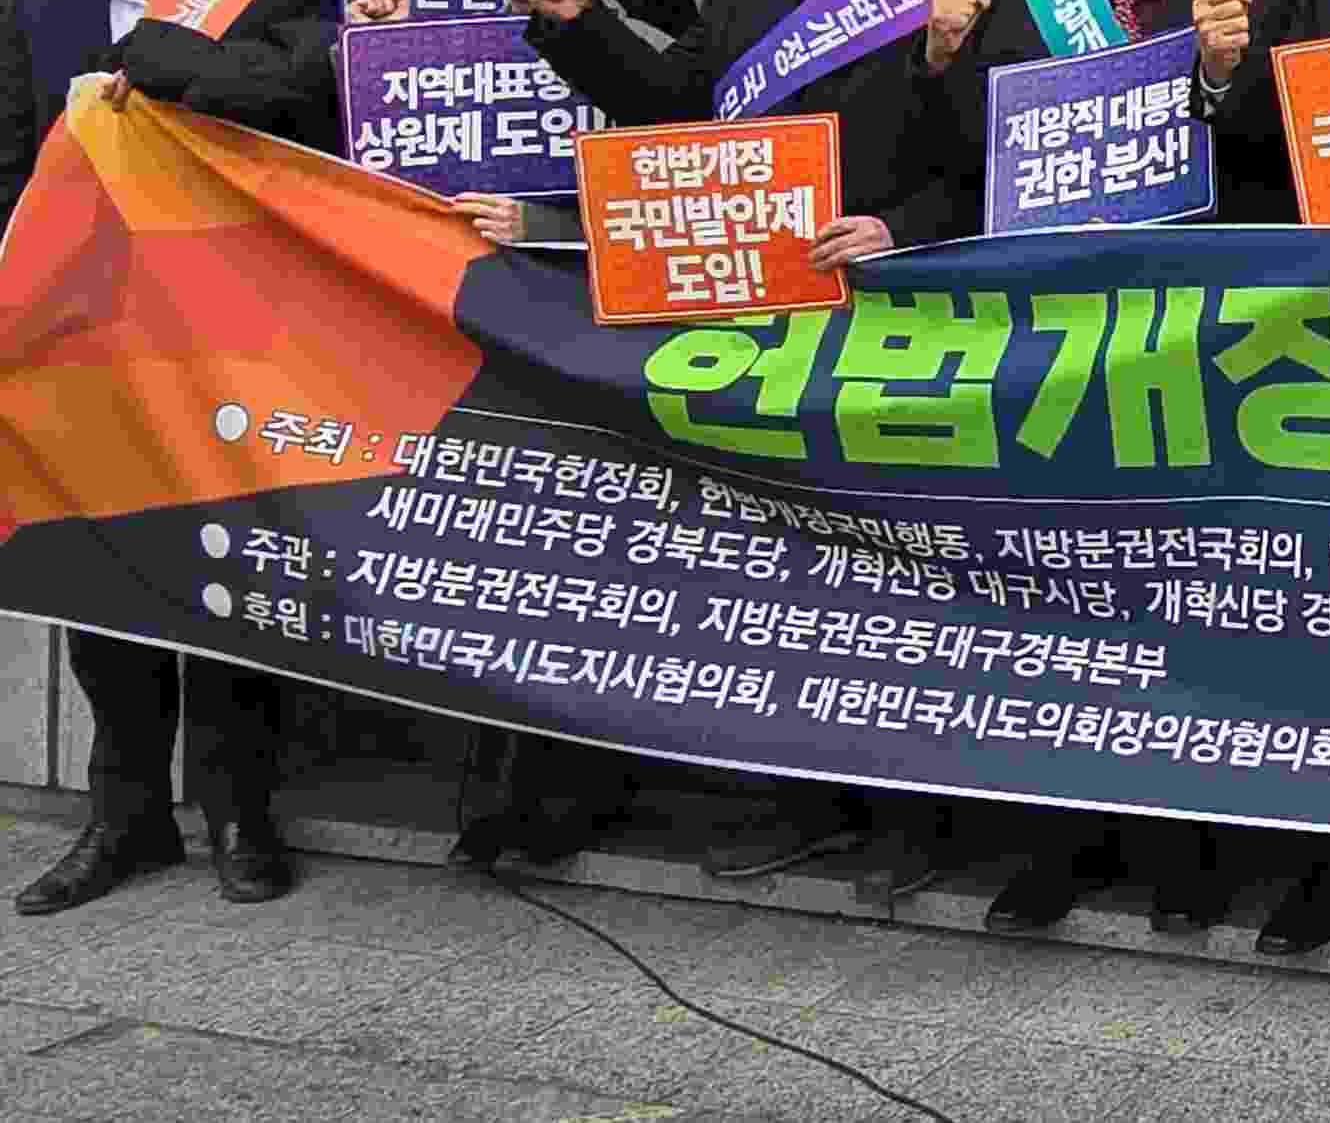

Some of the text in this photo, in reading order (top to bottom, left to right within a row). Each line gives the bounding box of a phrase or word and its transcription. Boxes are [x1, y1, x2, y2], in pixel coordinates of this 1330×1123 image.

[354, 109, 482, 170] 상원제
[1004, 95, 1105, 152] 제왕적
[631, 137, 774, 192] 헌법개정
[1015, 124, 1190, 210] 권한 분산!
[603, 184, 816, 251] 국민발안제
[666, 248, 767, 304] 도입!
[259, 410, 353, 465] 주최
[392, 433, 681, 513] 대한민국헌정회,
[698, 477, 985, 565] 헌법개정국민행동,
[994, 525, 1313, 582] 지방분권전국회의,
[366, 485, 616, 559] 새미래민주당
[626, 516, 791, 583] 경북도당,
[807, 543, 958, 602] 개혁신당
[968, 568, 1130, 622] 대구시당,
[1144, 579, 1289, 633] 개혁신당
[242, 526, 313, 581] 주관
[346, 548, 681, 637] 지방분권전국회의,
[698, 595, 1168, 690] 지방분권운동대구경북본부
[242, 590, 308, 641] 후원
[343, 613, 779, 717] 대한민국시도지사협의회,
